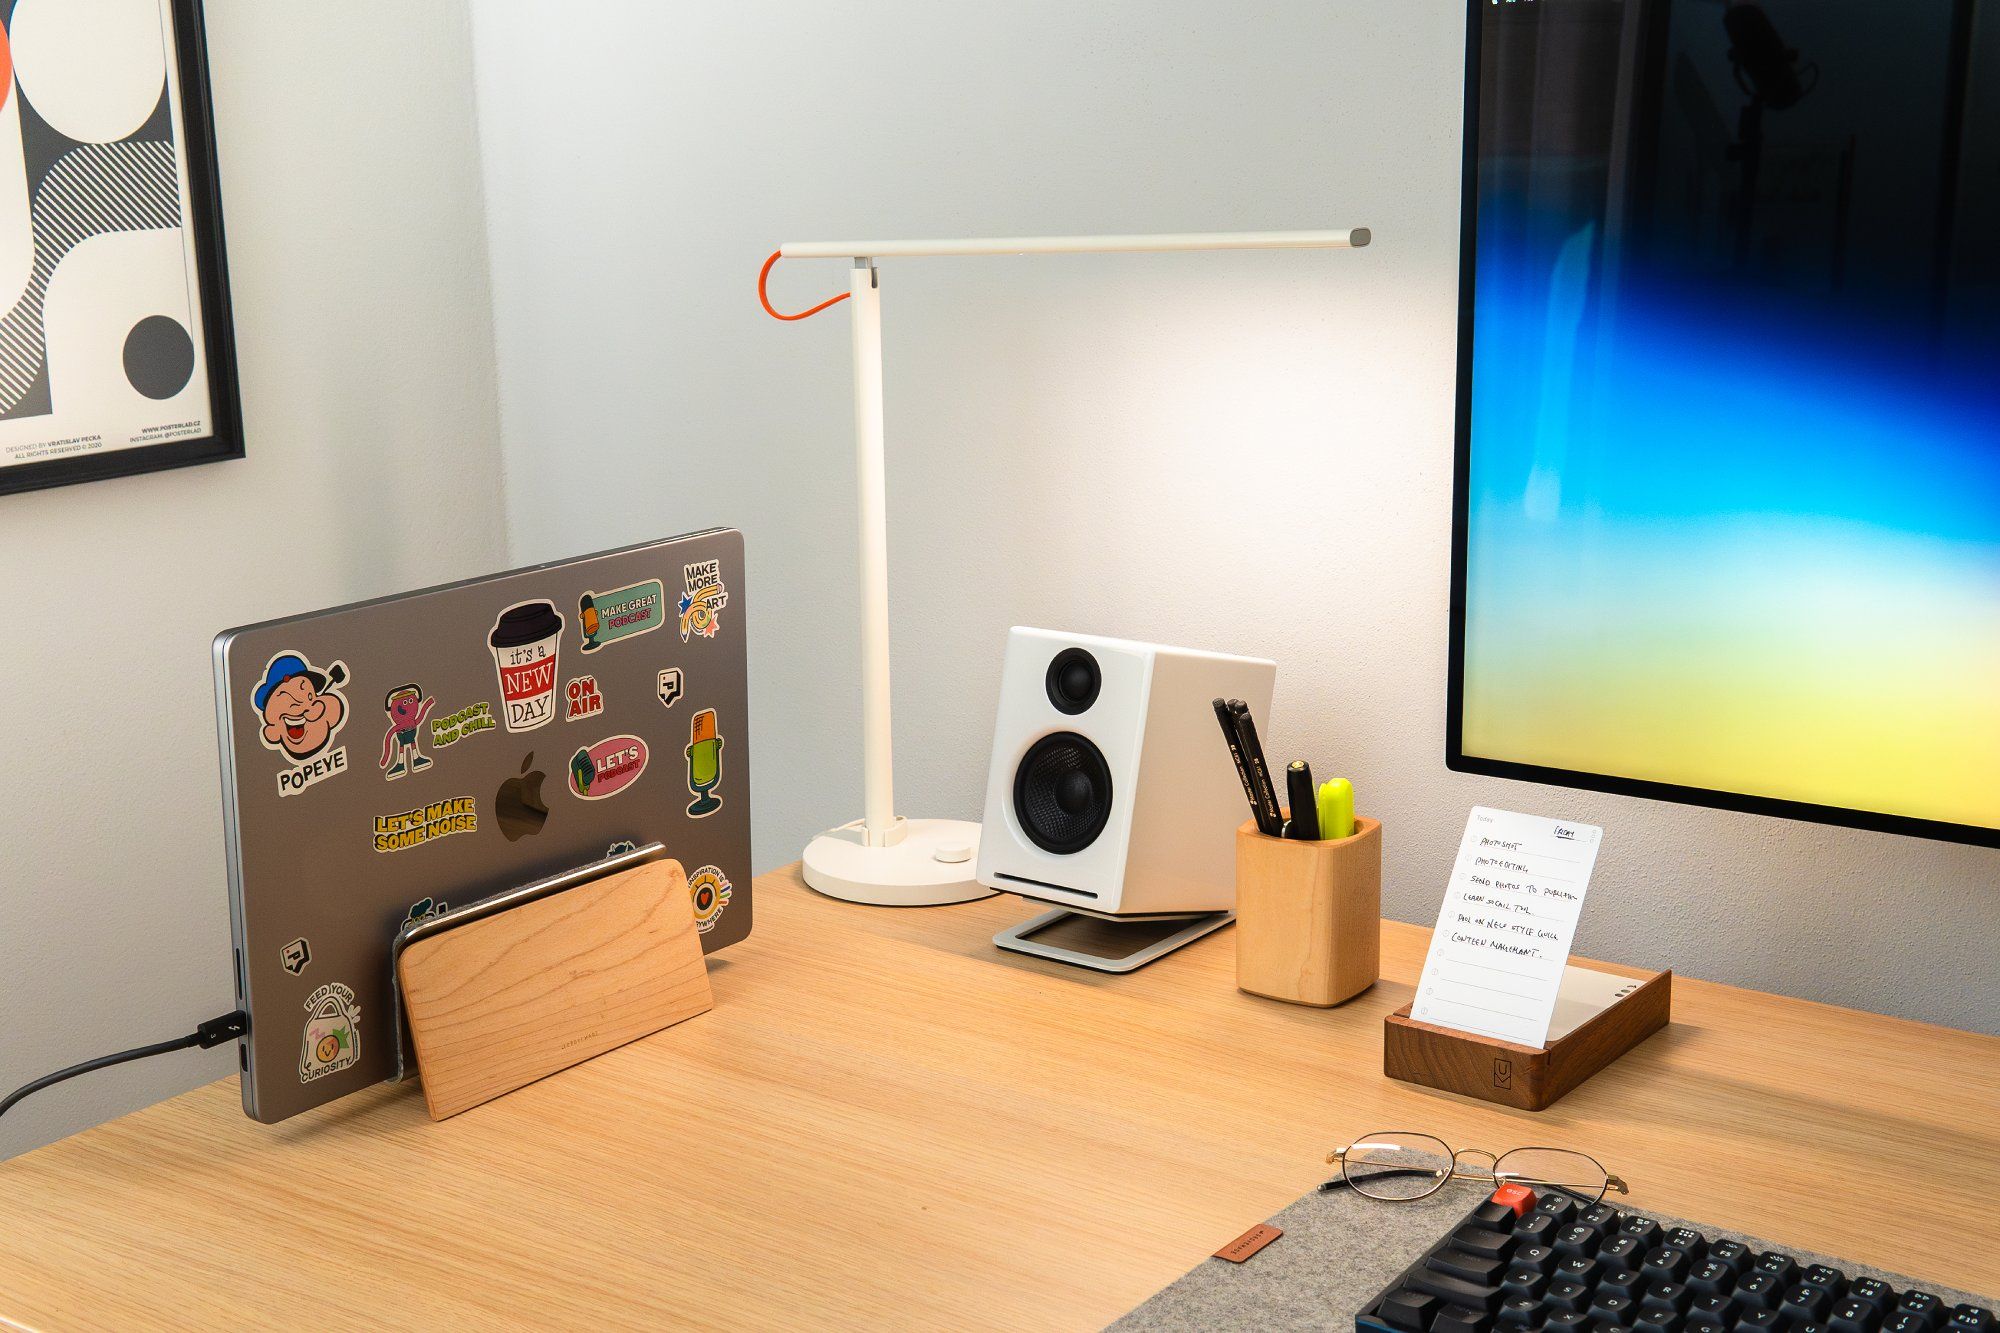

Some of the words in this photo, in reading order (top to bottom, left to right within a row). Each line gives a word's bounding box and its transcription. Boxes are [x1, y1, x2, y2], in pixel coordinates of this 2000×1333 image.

[141, 420, 201, 434] WWW.POSTERLAD.CZ
[164, 428, 202, 438] @POSTERLAD
[5, 442, 37, 453] DESIGNED
[48, 436, 80, 446] VRATISLAV
[26, 450, 49, 458] RIGHTS
[50, 446, 81, 454] RESERVED
[686, 562, 716, 580] MAKE
[688, 574, 718, 592] MORE
[600, 602, 627, 620] MAKE
[628, 594, 657, 610] GREAT
[706, 596, 726, 611] ART
[608, 608, 652, 630] PODCAST
[510, 648, 532, 665] it's
[538, 645, 546, 658] a
[505, 662, 554, 695] NEW
[568, 678, 595, 700] ON
[511, 694, 550, 724] DAY
[569, 694, 601, 717] AIR
[432, 703, 489, 732] PODCAST
[434, 728, 460, 746] AND
[461, 716, 496, 735] CHILL
[596, 746, 638, 772] LET'S
[280, 751, 344, 791] POPEYE
[597, 758, 641, 783] PODCAST
[375, 809, 424, 832] LET'S
[425, 798, 474, 822] MAKE
[375, 826, 426, 850] SOME
[426, 815, 477, 840] NOISE
[688, 868, 720, 887] INSPIRATION
[1470, 875, 1491, 886] SEND
[1495, 880, 1520, 890] PHOTOS
[1526, 884, 1538, 894] TO
[306, 986, 328, 1010] FEED
[331, 984, 353, 1004] YOUR
[302, 1057, 351, 1082] CURIOSITY
[1587, 1214, 1599, 1222] F2
[1765, 1262, 1777, 1270] F6
[1860, 1288, 1874, 1296] F8
[1845, 1310, 1854, 1318] 8
[1908, 1301, 1923, 1309] F9
[1958, 1314, 1978, 1324] F10
